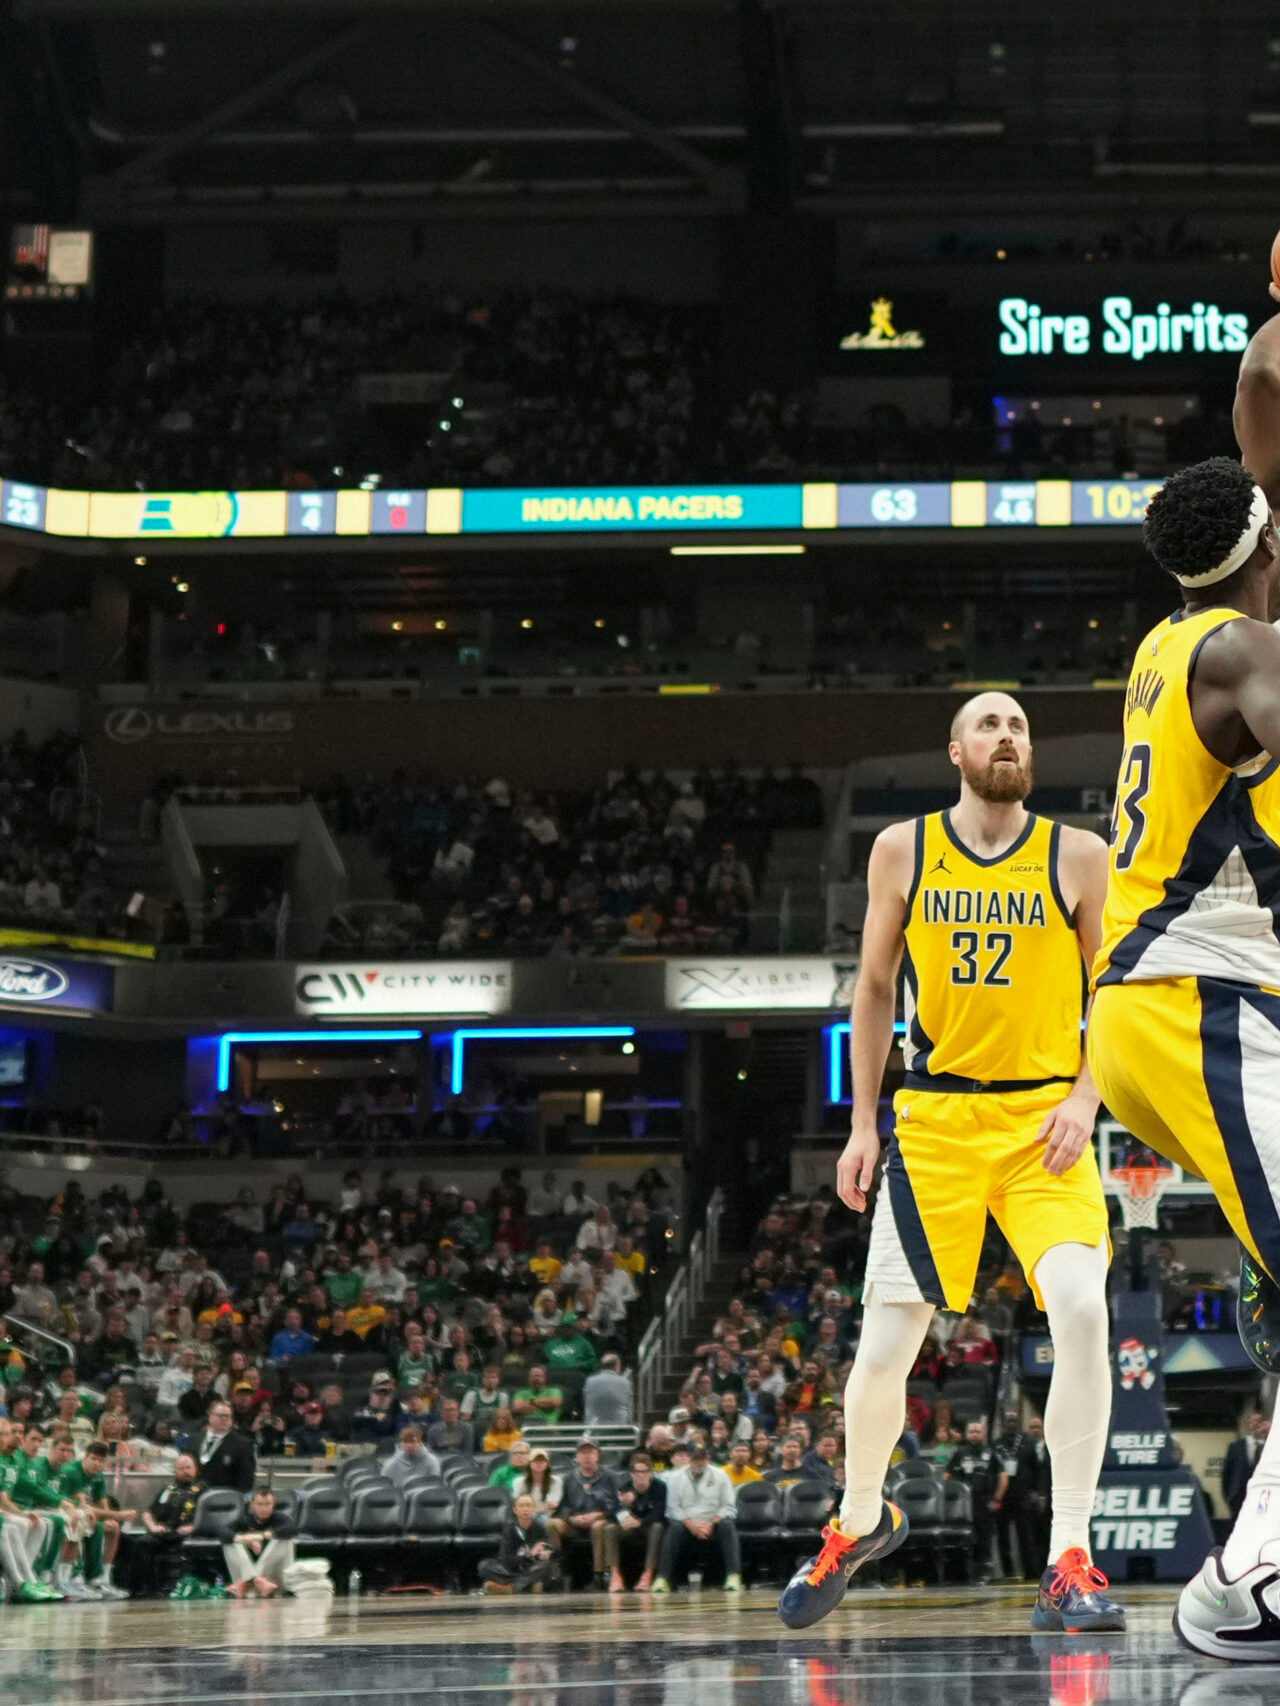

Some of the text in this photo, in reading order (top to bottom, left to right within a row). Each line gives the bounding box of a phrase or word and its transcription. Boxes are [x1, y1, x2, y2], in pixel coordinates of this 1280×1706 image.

[999, 297, 1249, 360] Sire Spirits
[6, 498, 39, 525] 23
[390, 506, 409, 529] 0
[521, 495, 744, 522] INDIANA PACERS
[870, 488, 918, 522] 63
[300, 508, 323, 532] 4
[924, 889, 1046, 927] INDIANA
[951, 930, 1015, 986] 32
[383, 976, 437, 988] CITY
[448, 973, 506, 987] WIDE
[740, 973, 812, 986] XIBER
[1111, 1433, 1166, 1449] BELLE
[1117, 1450, 1159, 1465] TIRE
[1091, 1521, 1178, 1550] TIRE
